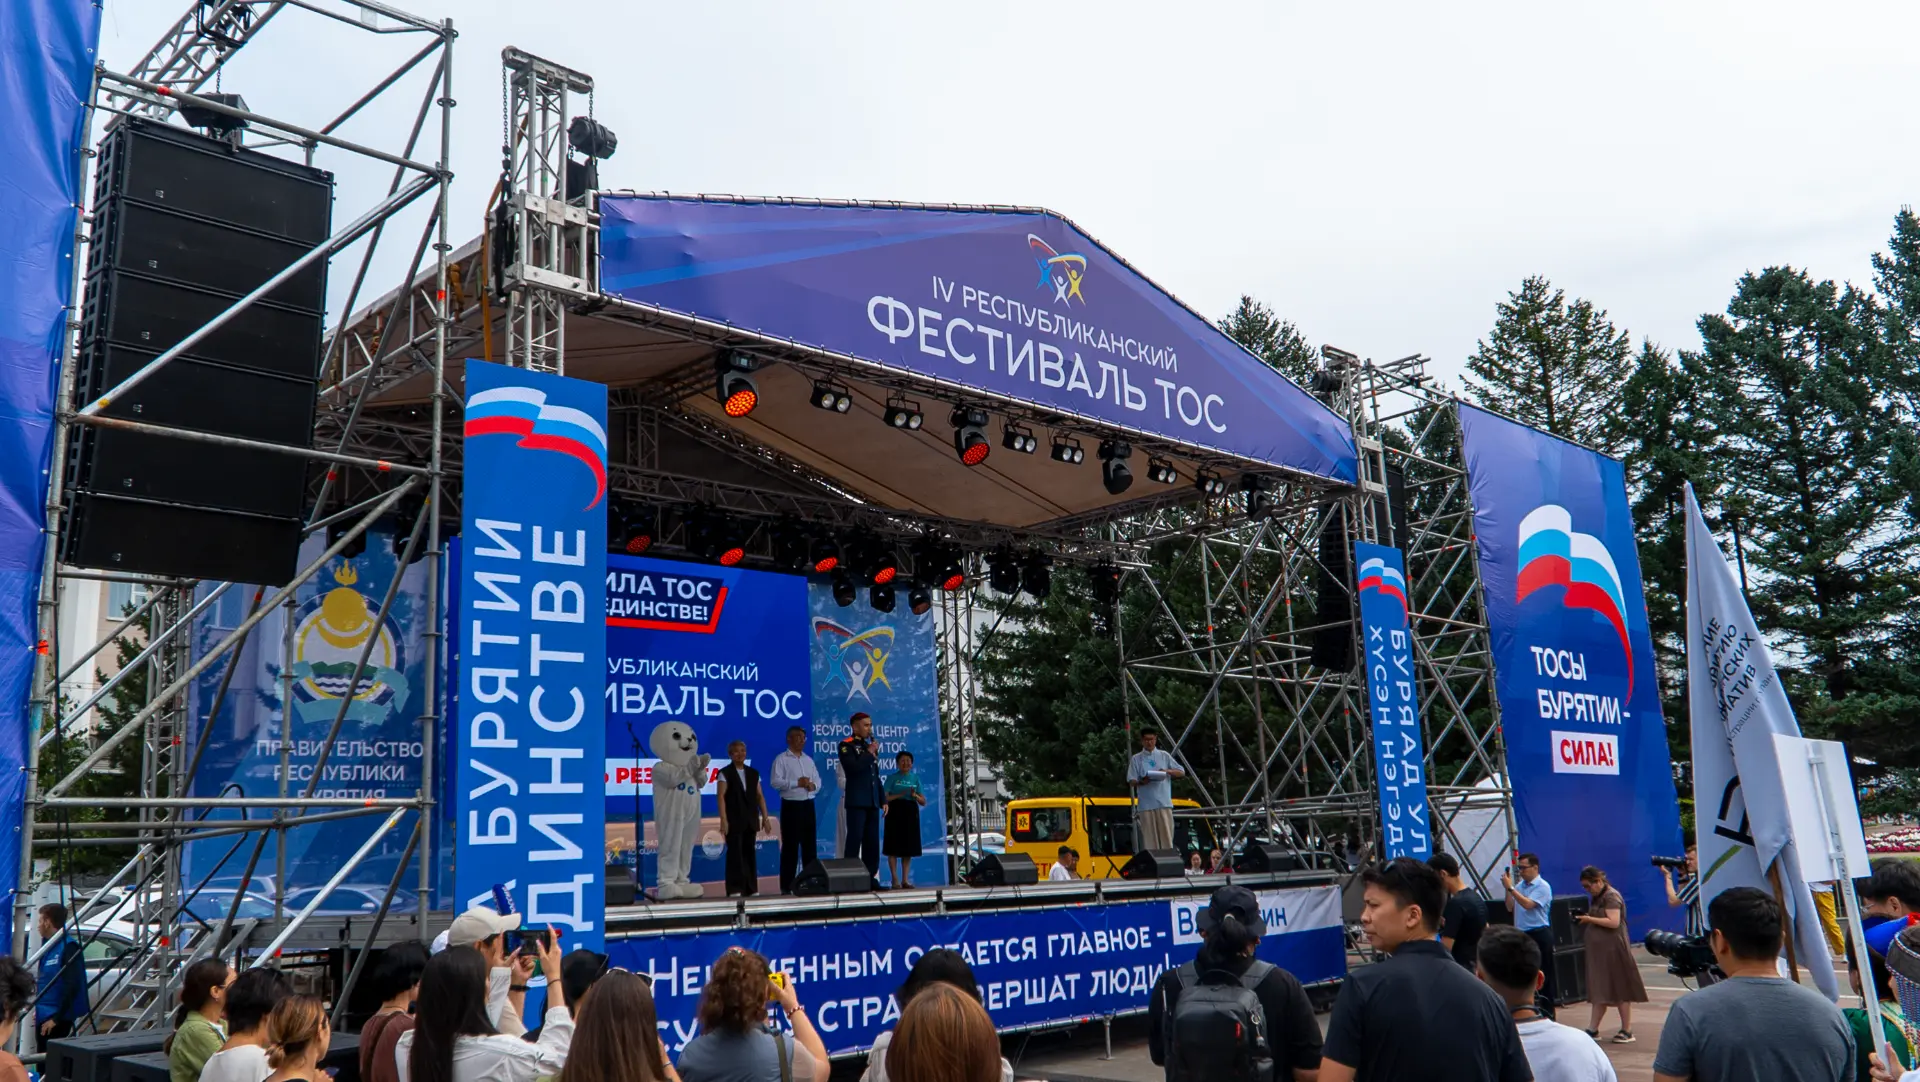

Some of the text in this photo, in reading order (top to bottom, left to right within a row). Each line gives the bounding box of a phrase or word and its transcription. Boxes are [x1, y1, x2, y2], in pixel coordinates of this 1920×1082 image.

[931, 275, 1179, 373] IV РЕСПУБЛИКАНСКИЙ
[866, 295, 1228, 434] ФЕСТИВАЛЬ ТОС
[662, 577, 712, 601] ТОС
[1530, 646, 1587, 681] ТОСЫ
[468, 518, 522, 846] БУРЯТИИ
[734, 689, 803, 719] ТОС
[1390, 629, 1420, 787] БУРЯД
[256, 740, 424, 758] ПРАВИЕЛЬСТВО
[526, 525, 595, 958] ДИНСТВЕ
[876, 726, 909, 739] ЦЕНТР
[1560, 738, 1614, 766] СИЛА!
